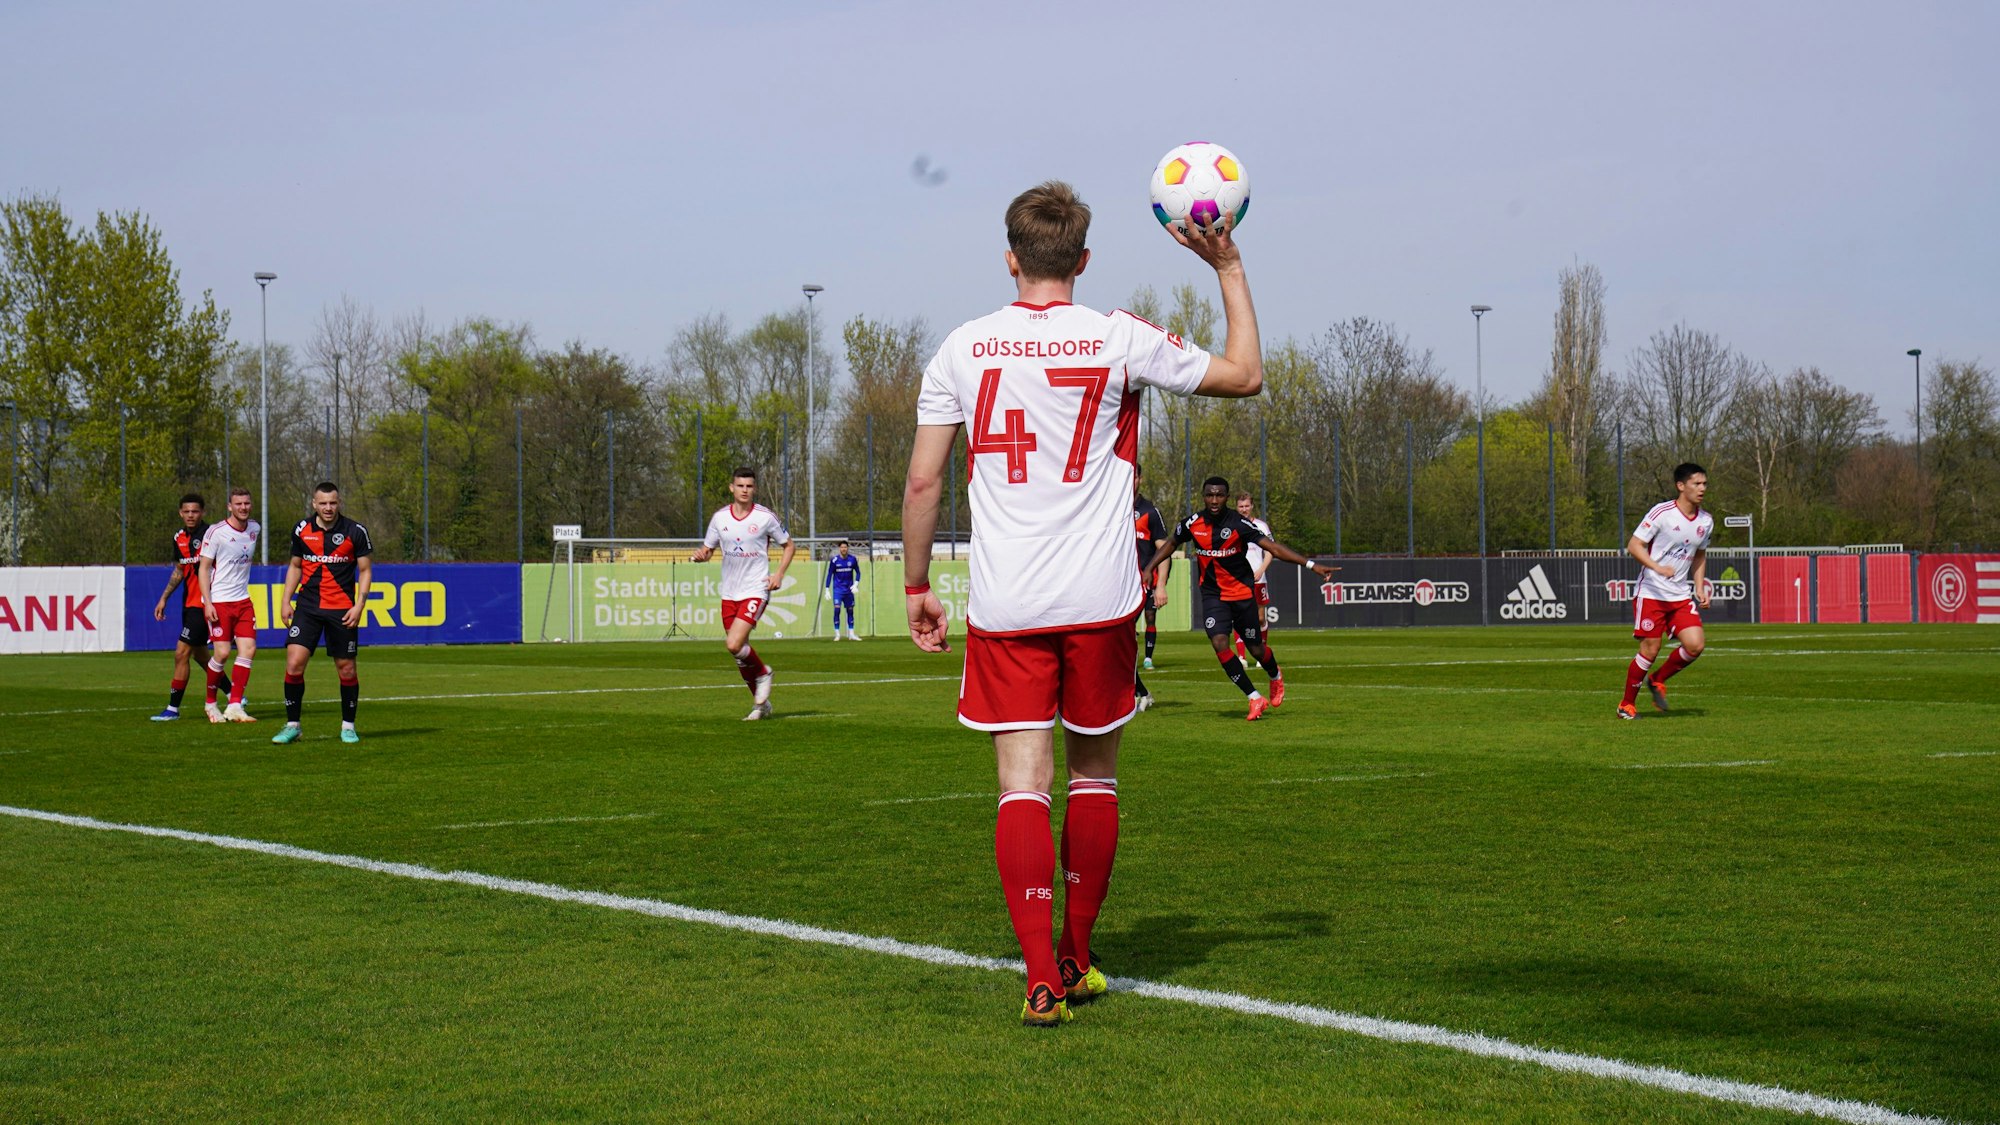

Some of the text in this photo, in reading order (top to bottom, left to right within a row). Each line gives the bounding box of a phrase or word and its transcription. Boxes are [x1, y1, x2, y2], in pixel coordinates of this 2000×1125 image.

[972, 337, 1104, 358] DÜSSELDORF
[972, 367, 1111, 484] 47
[556, 528, 580, 536] Platz 4
[1321, 579, 1469, 606] 11TEAMSPORTS
[595, 603, 722, 626] Düsseldor
[747, 600, 758, 613] 6
[1500, 599, 1567, 619] adidas
